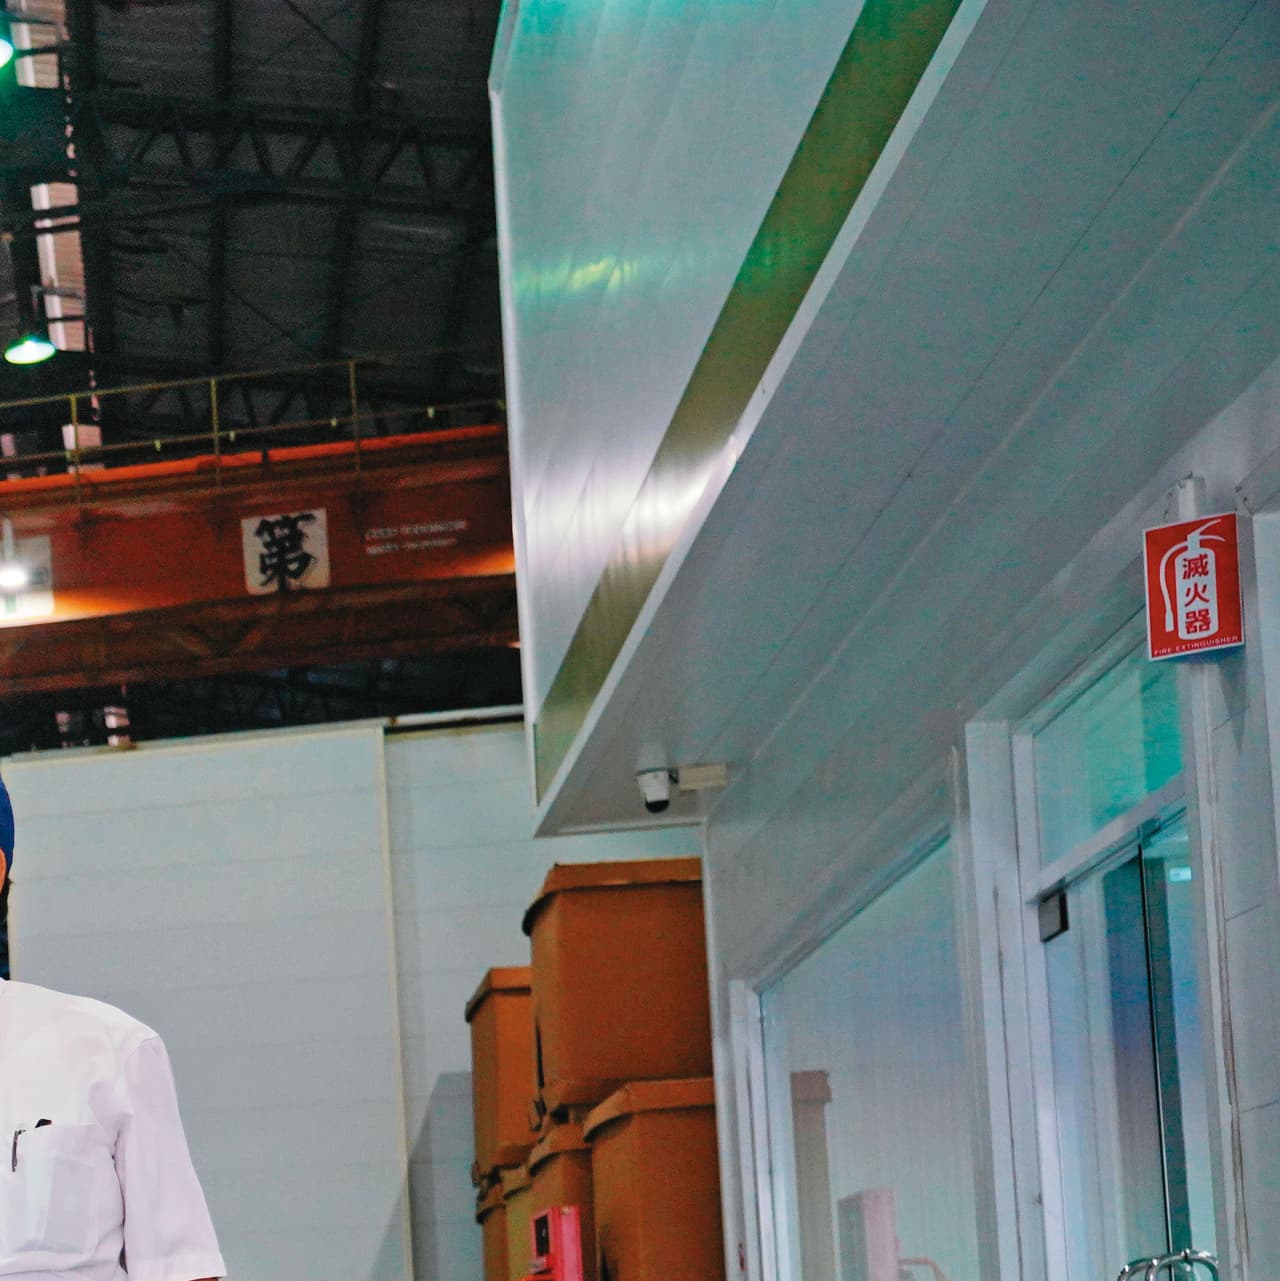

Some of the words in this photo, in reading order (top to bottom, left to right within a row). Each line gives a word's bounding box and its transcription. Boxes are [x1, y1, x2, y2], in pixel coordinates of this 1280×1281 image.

[255, 513, 317, 594] 第
[1182, 553, 1211, 634] 滅火器
[1154, 647, 1172, 656] FIRE
[1175, 636, 1238, 653] EXTINGUISHER
